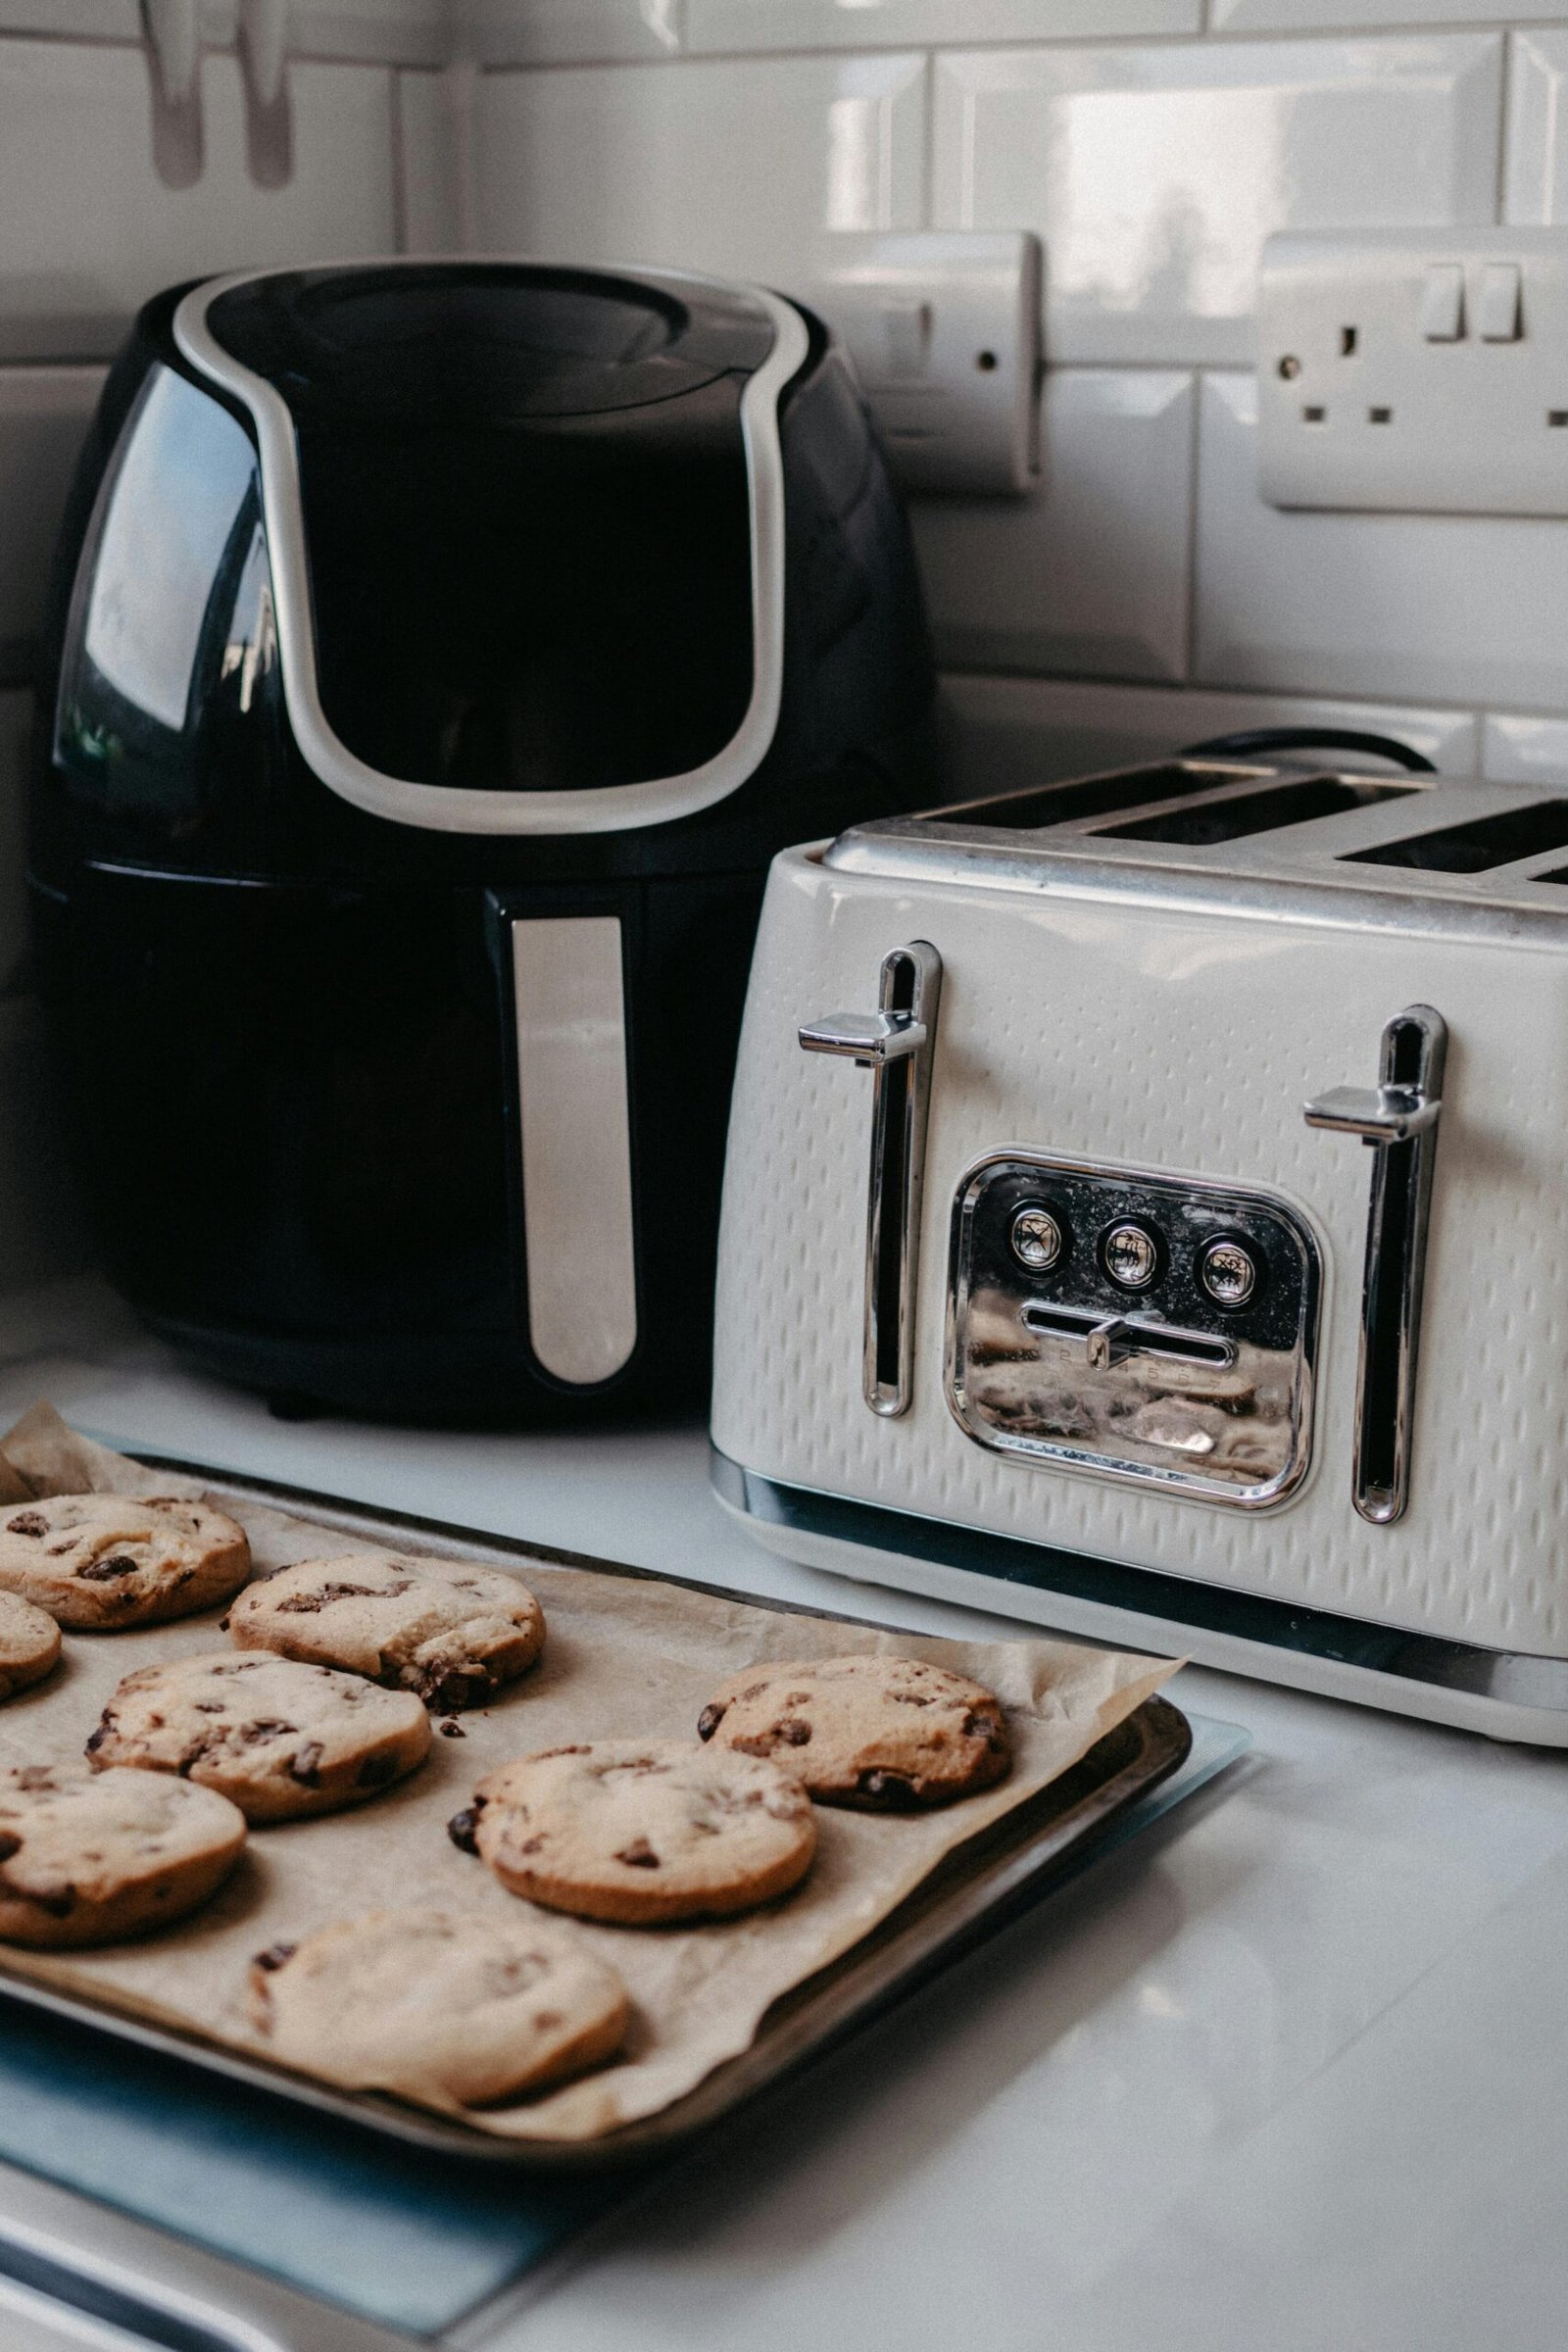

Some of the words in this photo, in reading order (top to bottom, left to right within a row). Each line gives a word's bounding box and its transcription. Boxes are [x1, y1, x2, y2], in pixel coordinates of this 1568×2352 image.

[1059, 1348, 1072, 1363] 2
[1118, 1359, 1129, 1373] 4
[1148, 1367, 1158, 1380] 5
